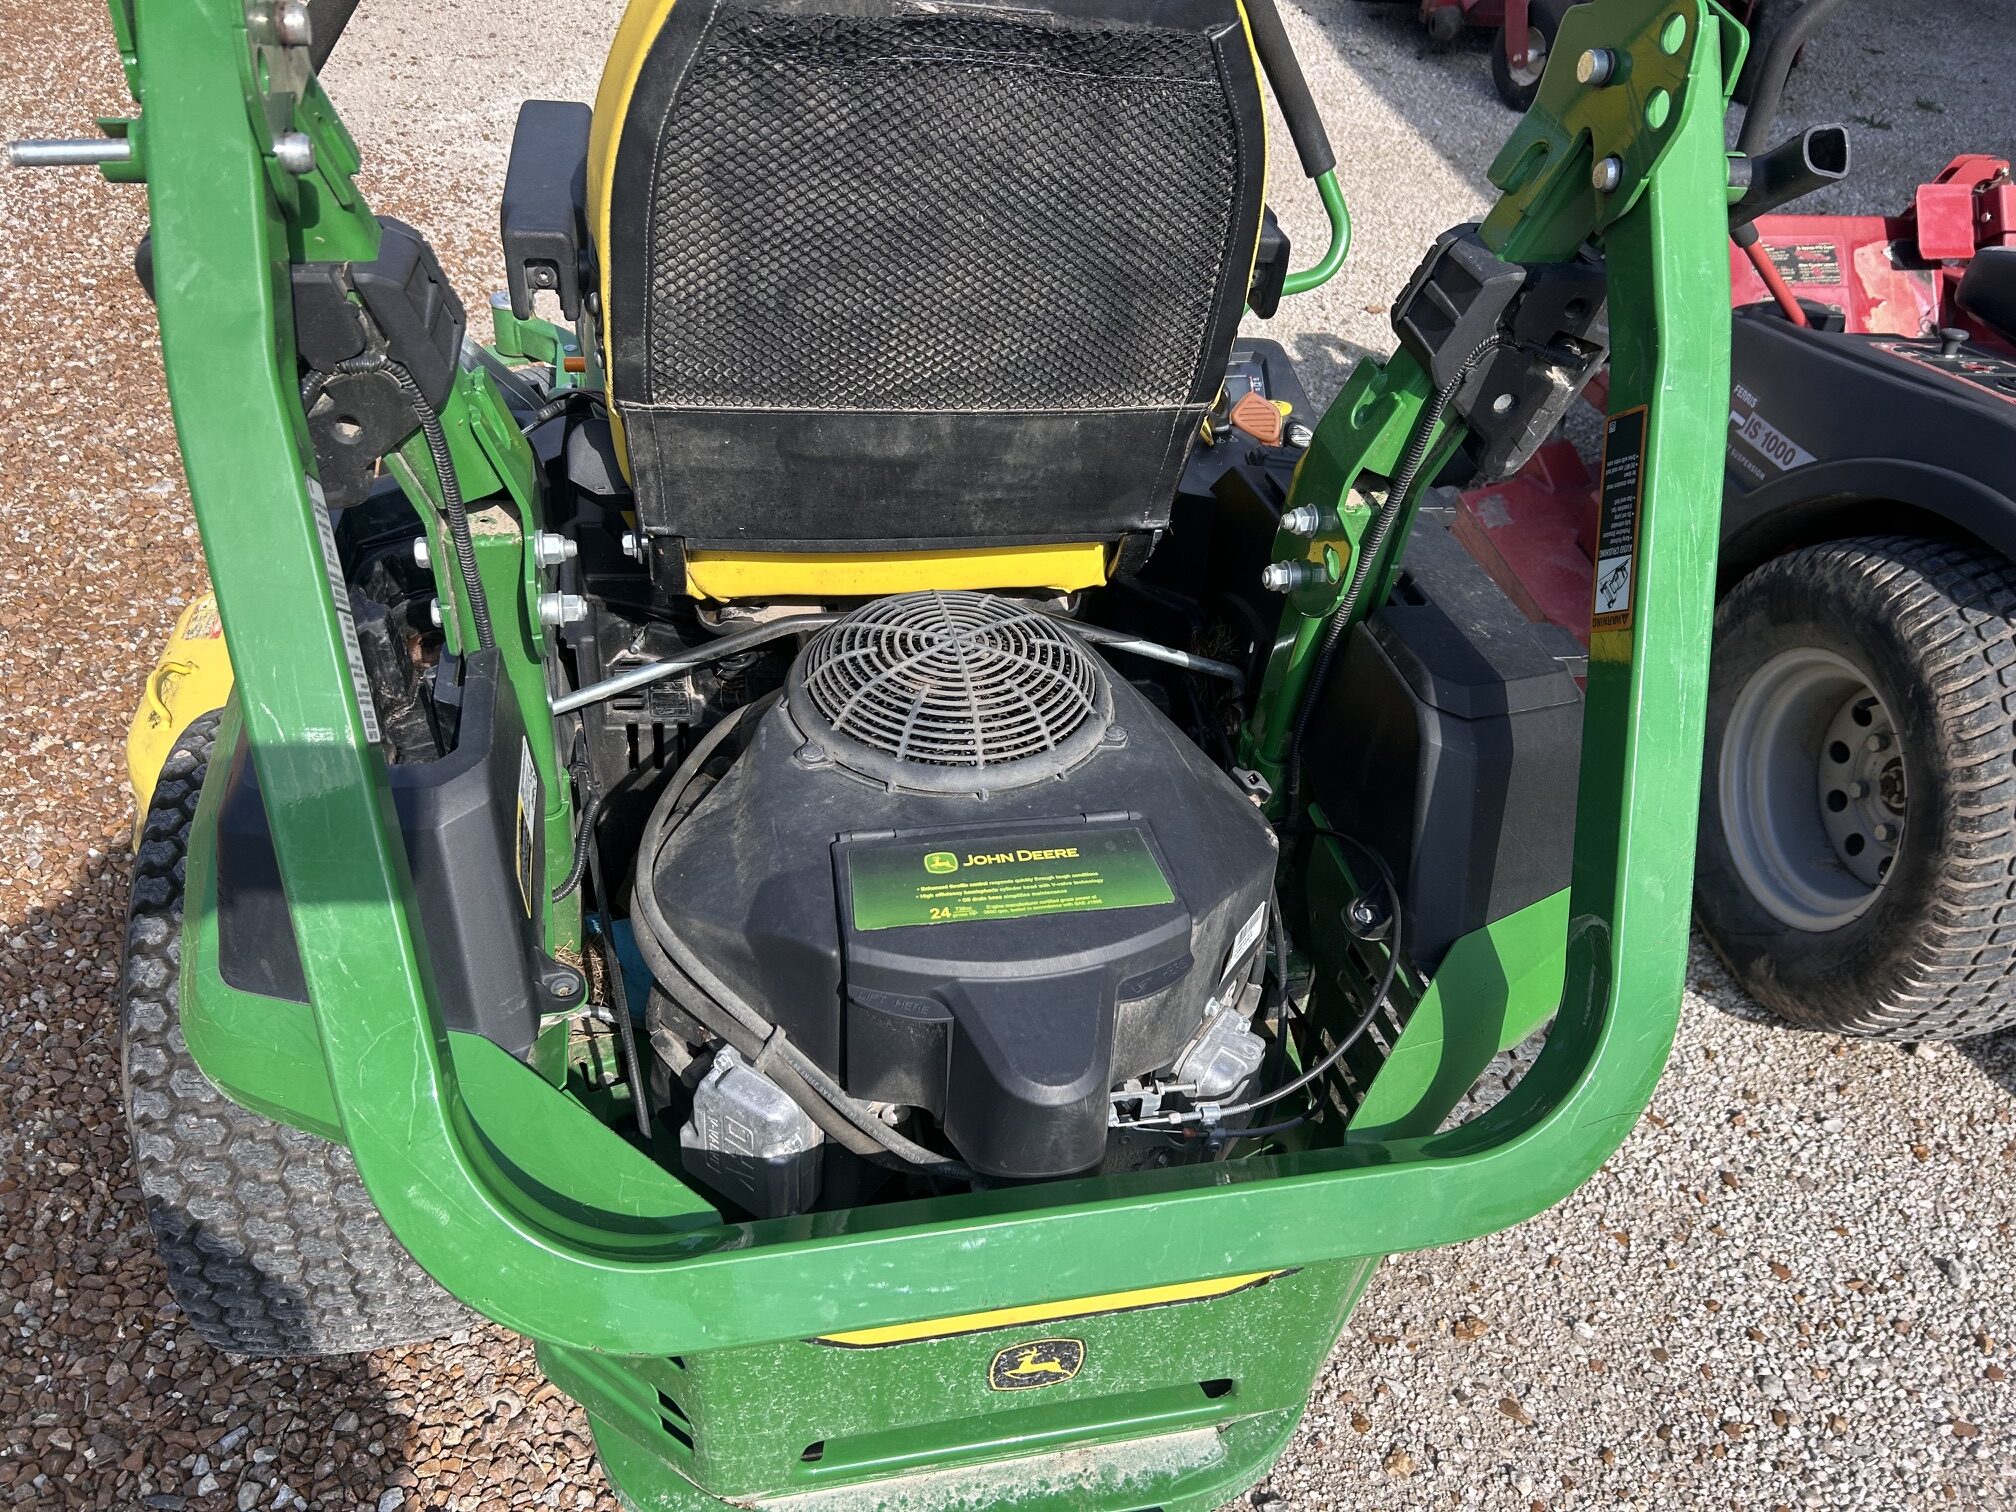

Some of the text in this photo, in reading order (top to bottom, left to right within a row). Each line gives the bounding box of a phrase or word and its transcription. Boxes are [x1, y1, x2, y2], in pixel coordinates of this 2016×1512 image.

[1733, 384, 1758, 408] FERRIS
[1743, 418, 1796, 466] IS 1000
[1730, 449, 1766, 480] SUSPENSION
[1599, 544, 1632, 558] AVOID CRUSHING
[1592, 614, 1622, 628] WARNING
[963, 847, 1080, 867] JOHN DEERE
[930, 906, 952, 920] 24
[857, 991, 930, 1015] LIFT HERE
